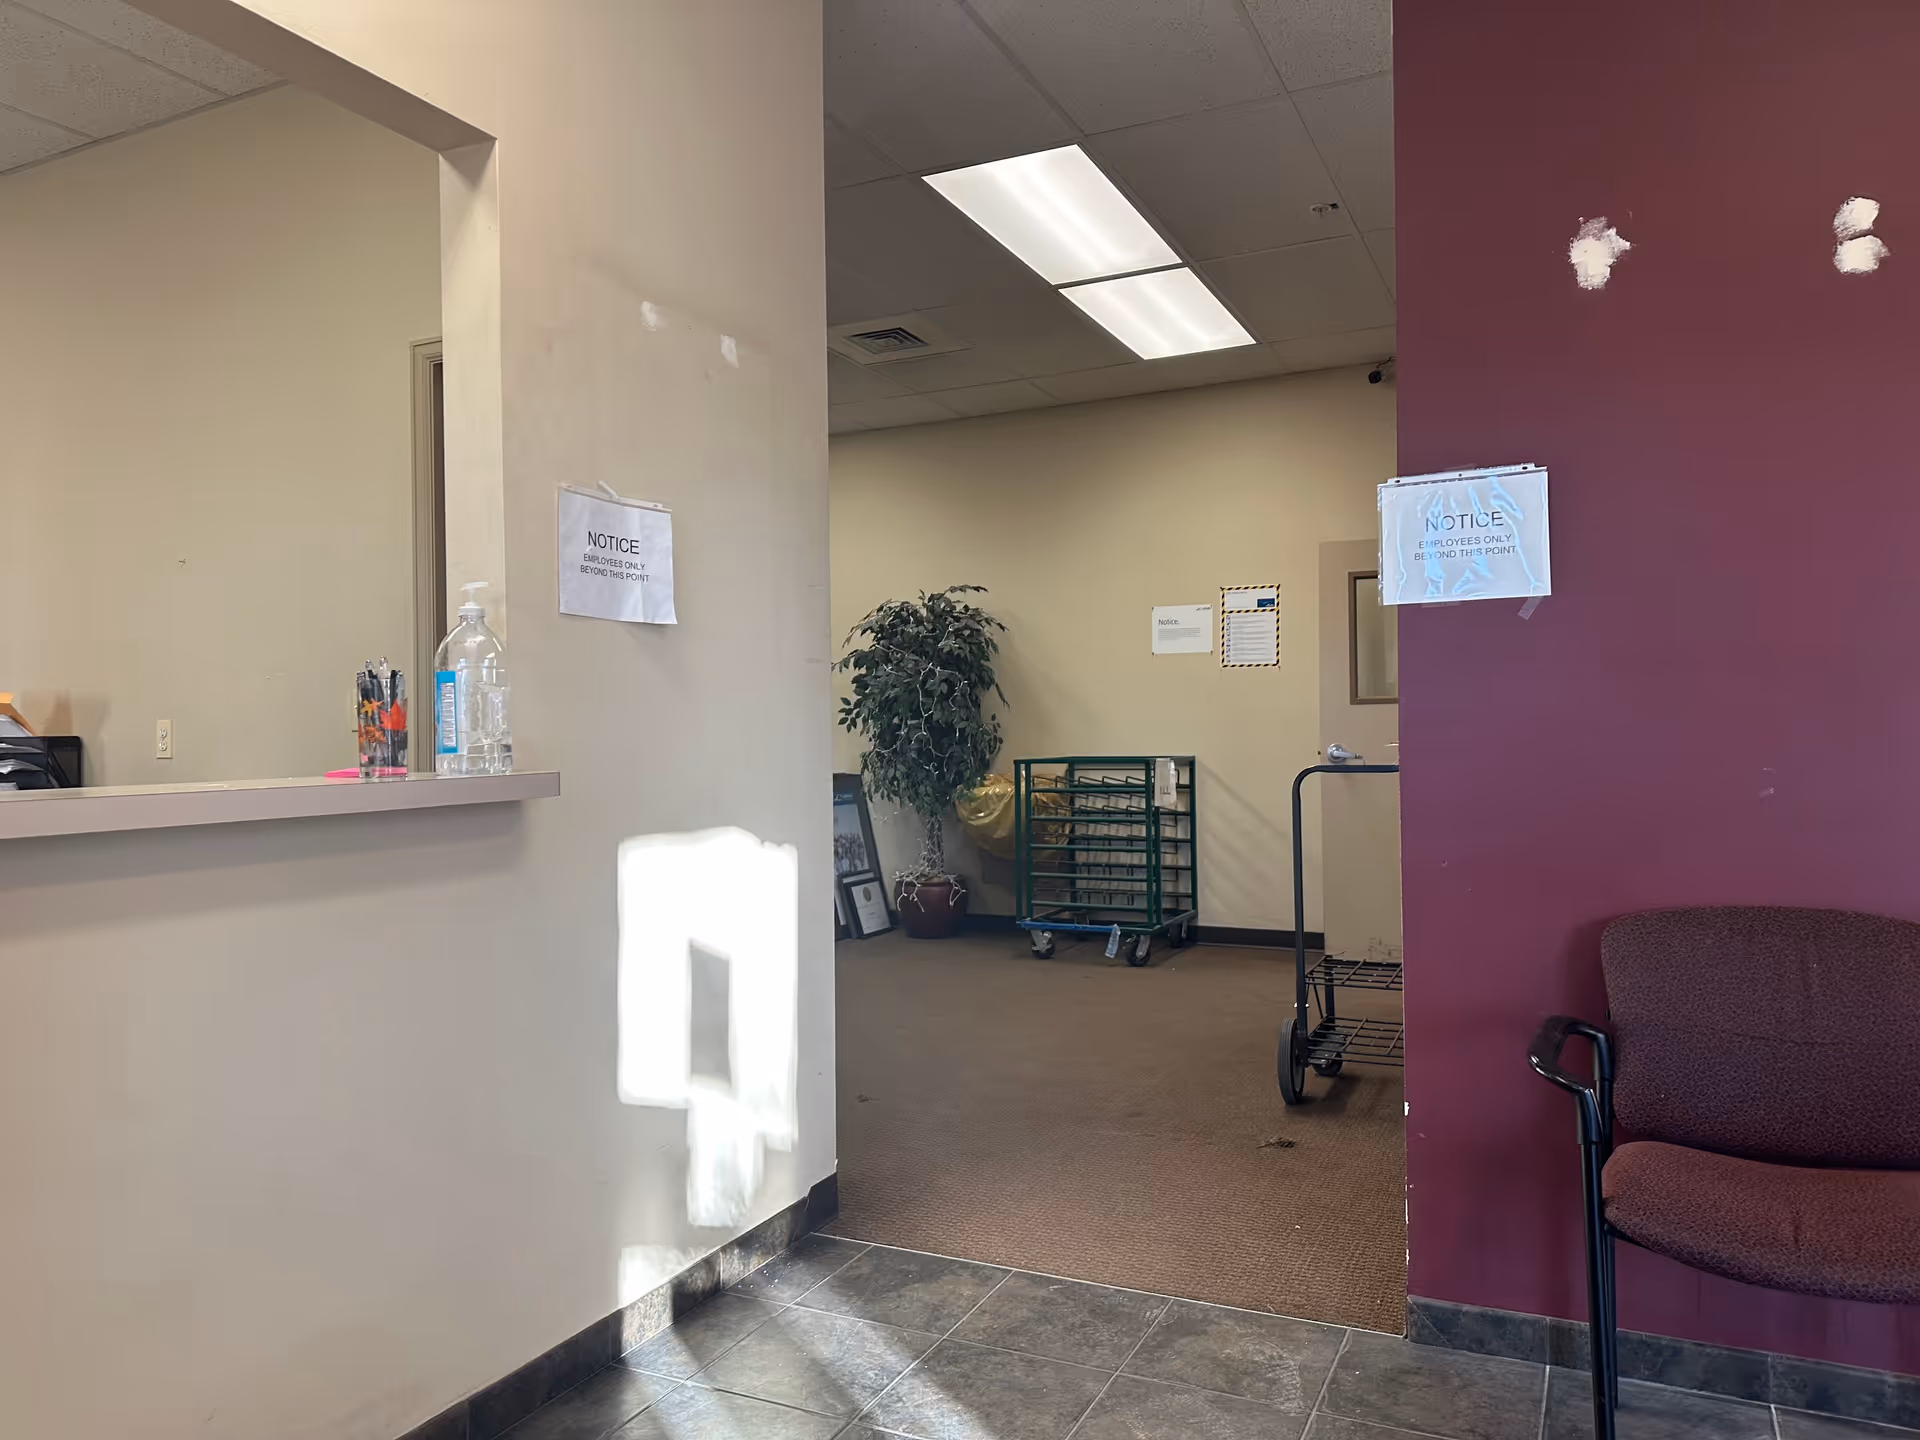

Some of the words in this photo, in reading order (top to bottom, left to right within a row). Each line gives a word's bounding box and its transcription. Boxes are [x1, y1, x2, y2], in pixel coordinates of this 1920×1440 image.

[1425, 511, 1504, 532] NOTICE
[588, 530, 640, 555] NOTICE
[1418, 536, 1481, 549] EMPLOYEES
[1484, 533, 1512, 545] ONLY
[583, 553, 624, 569] EMPLOYEES
[624, 561, 646, 571] ONLY
[1414, 550, 1457, 561] BEYOND
[1460, 547, 1483, 558] THIS
[1485, 545, 1517, 556] POINT
[580, 564, 608, 577] BEYOND
[608, 569, 625, 580] THIS
[625, 572, 650, 582] POINT
